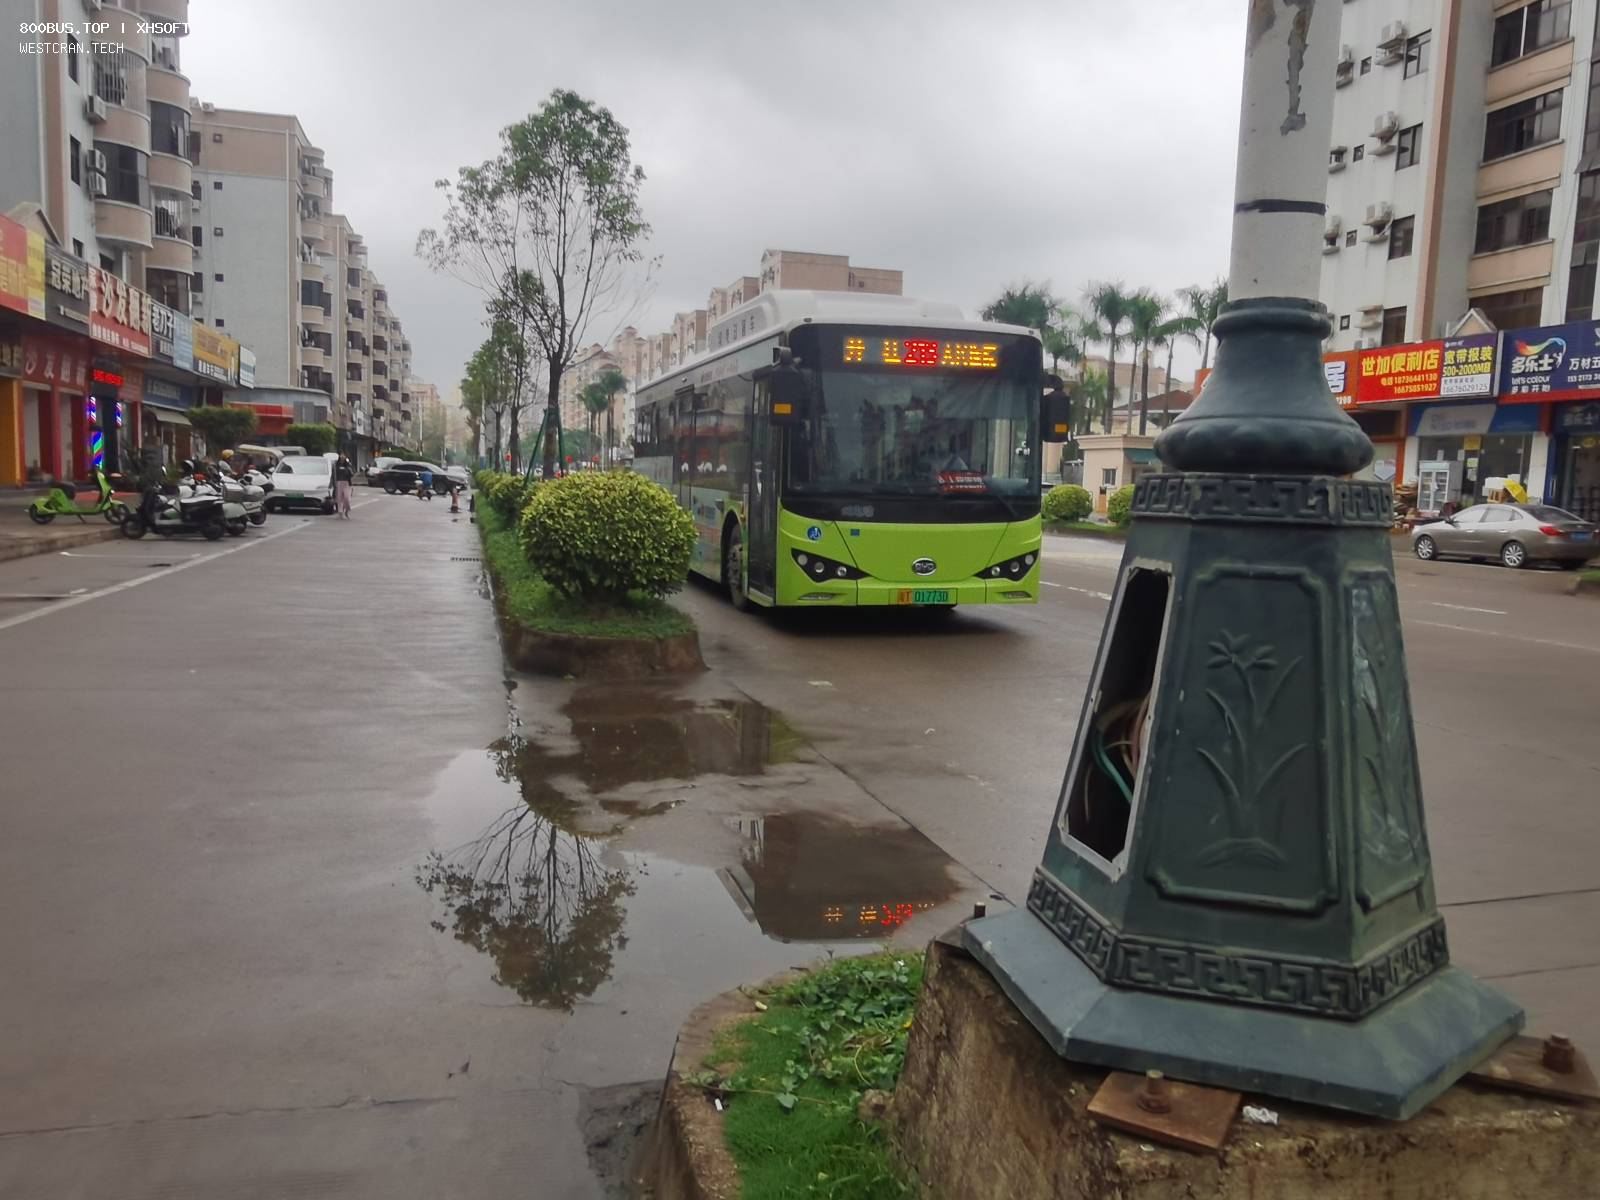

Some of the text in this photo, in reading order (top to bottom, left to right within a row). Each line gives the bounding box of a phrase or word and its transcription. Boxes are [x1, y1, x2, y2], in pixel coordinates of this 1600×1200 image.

[1361, 348, 1441, 377] 世加便利店
[1511, 353, 1554, 374] 多乐士
